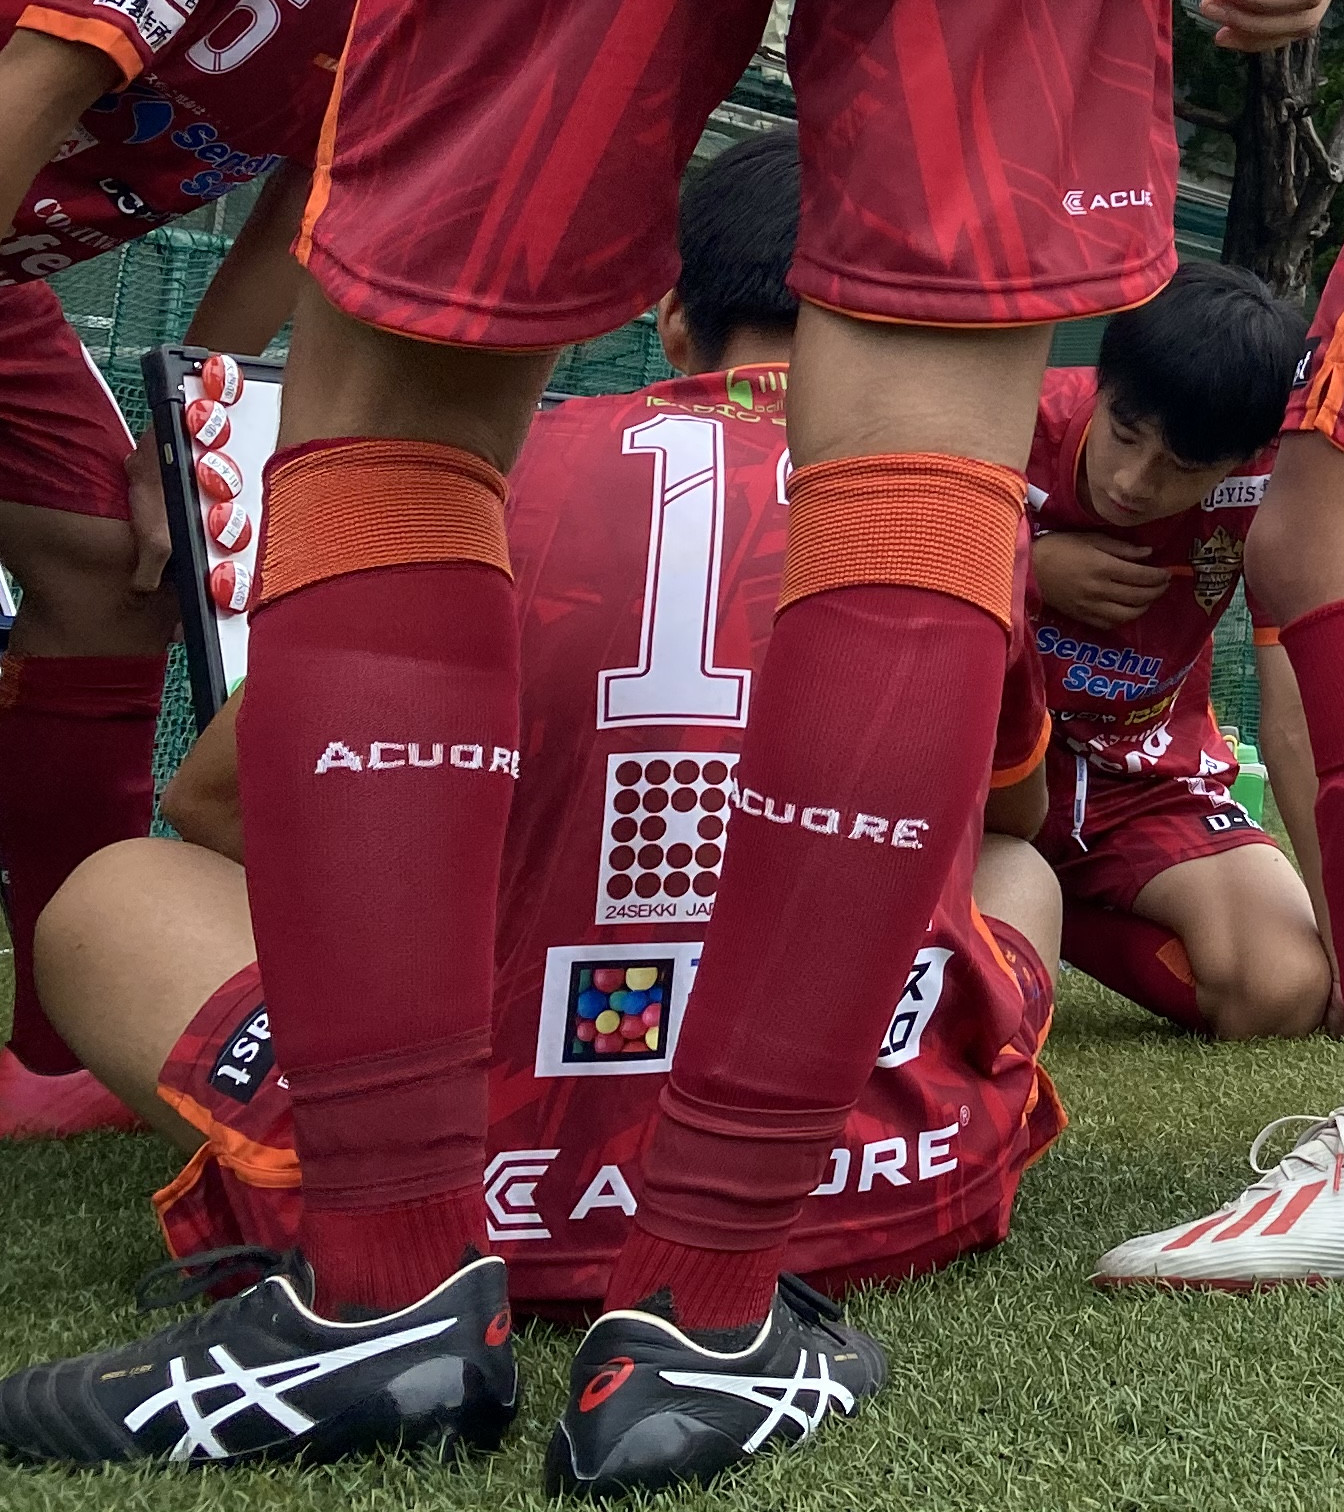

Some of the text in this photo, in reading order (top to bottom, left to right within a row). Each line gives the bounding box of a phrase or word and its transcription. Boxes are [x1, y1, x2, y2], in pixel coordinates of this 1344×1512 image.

[596, 413, 792, 730] 1
[1036, 626, 1164, 678] Senshu
[605, 904, 678, 920] 24SEKKI
